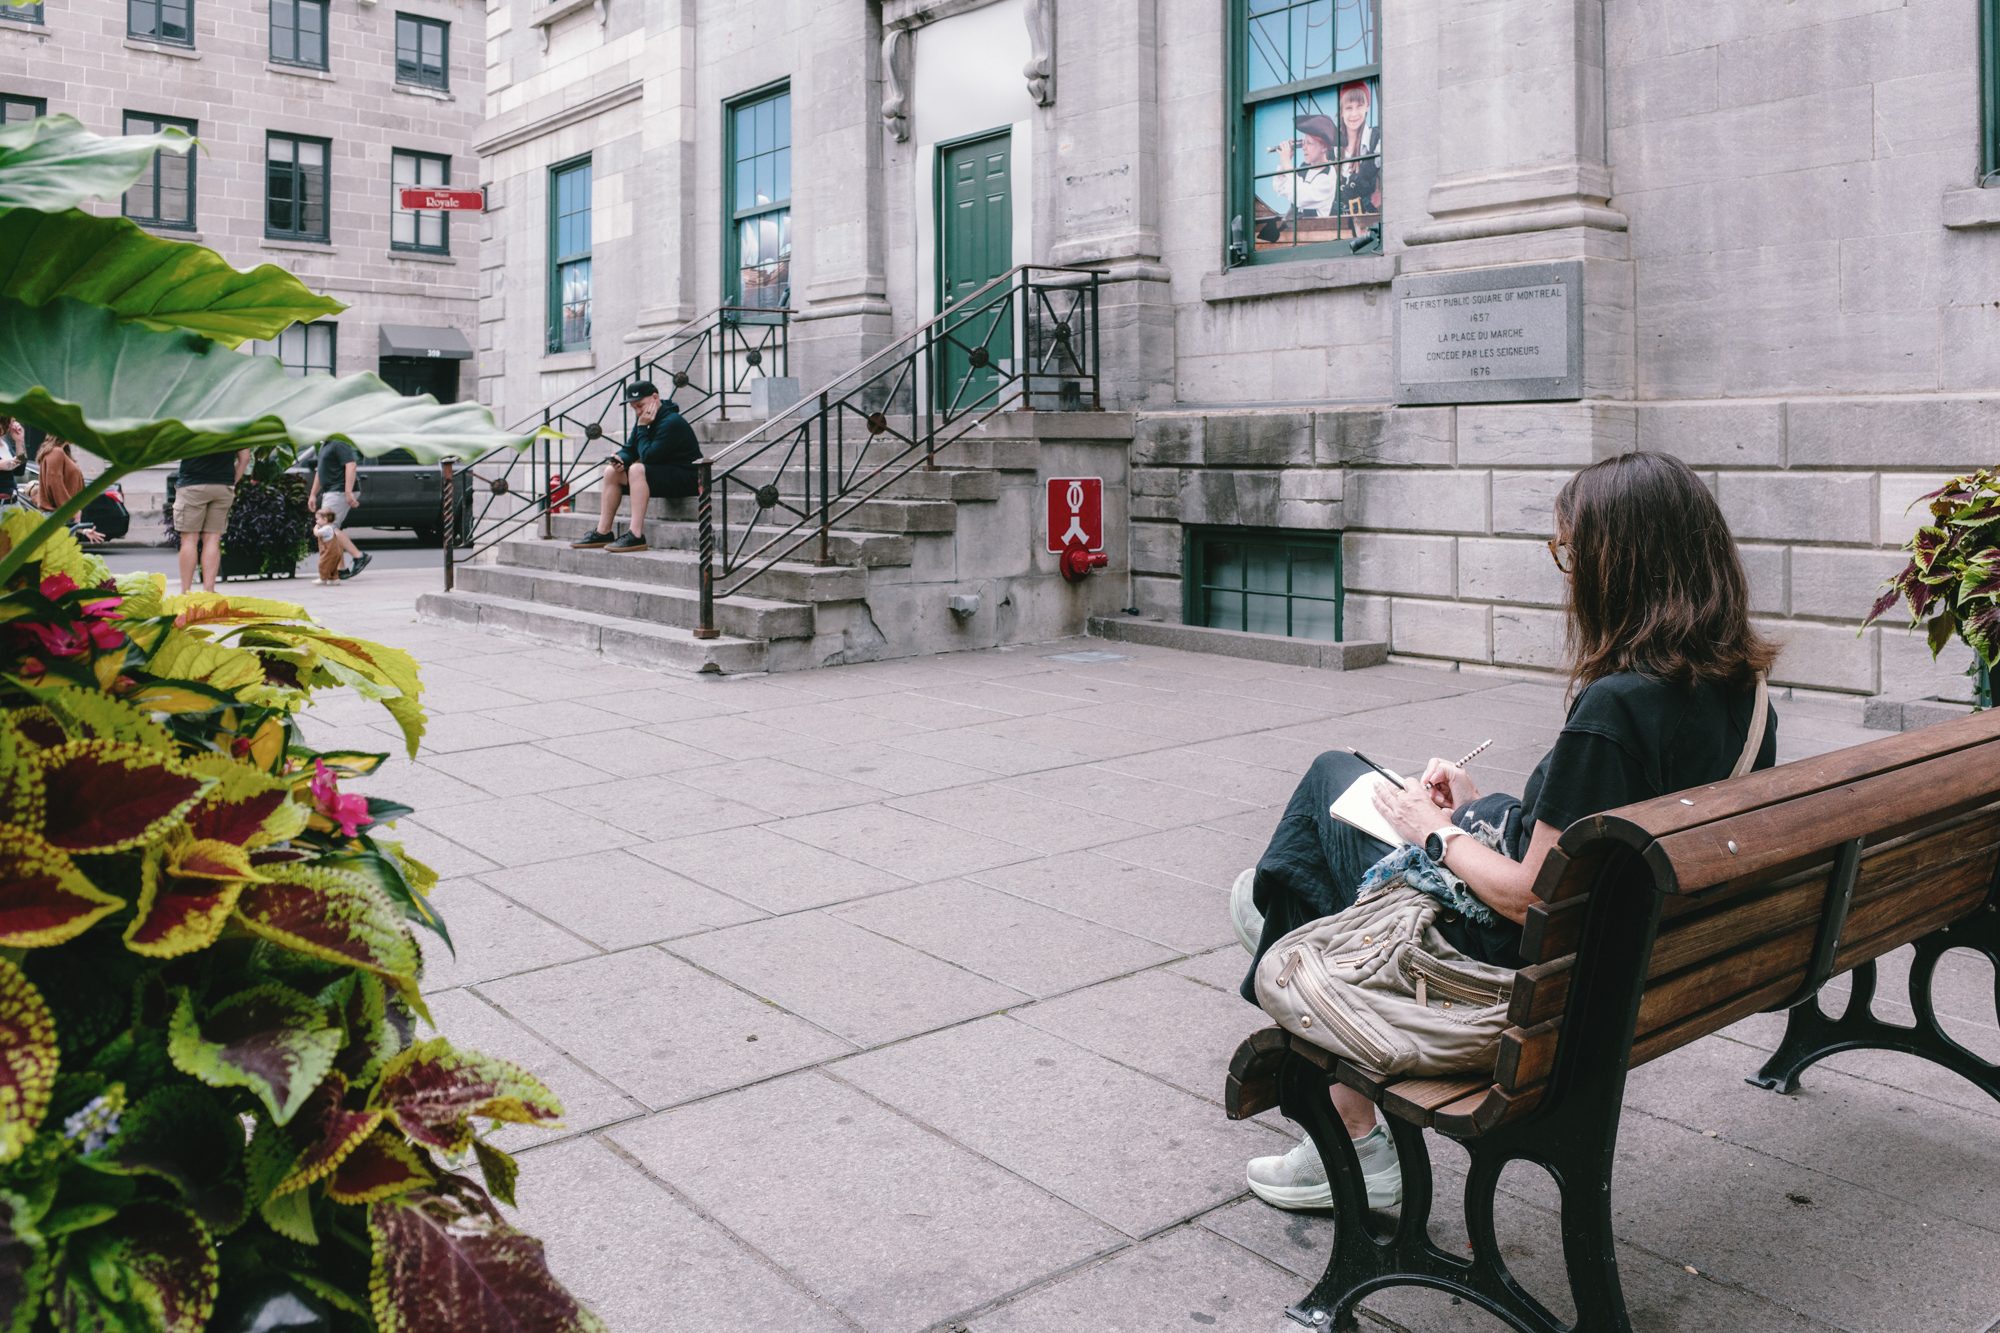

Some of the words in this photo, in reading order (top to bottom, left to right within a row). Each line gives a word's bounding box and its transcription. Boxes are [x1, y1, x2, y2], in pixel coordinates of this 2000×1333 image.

[426, 196, 460, 209] Royale
[1405, 301, 1420, 310] THE
[1420, 299, 1441, 309] FIRST
[1443, 296, 1470, 307] PUBLIC
[1472, 293, 1503, 304] SQUARE
[1504, 292, 1514, 302] OF
[1516, 288, 1562, 301] MONTREAL
[1470, 313, 1490, 322] 1657
[1438, 334, 1448, 343] LA
[1451, 331, 1476, 342] PLACE
[1478, 331, 1489, 340] DU
[1461, 350, 1478, 359] PAR
[1479, 348, 1494, 358] LES
[1496, 345, 1540, 357] SEIGNEURS
[1470, 366, 1491, 376] 1676
